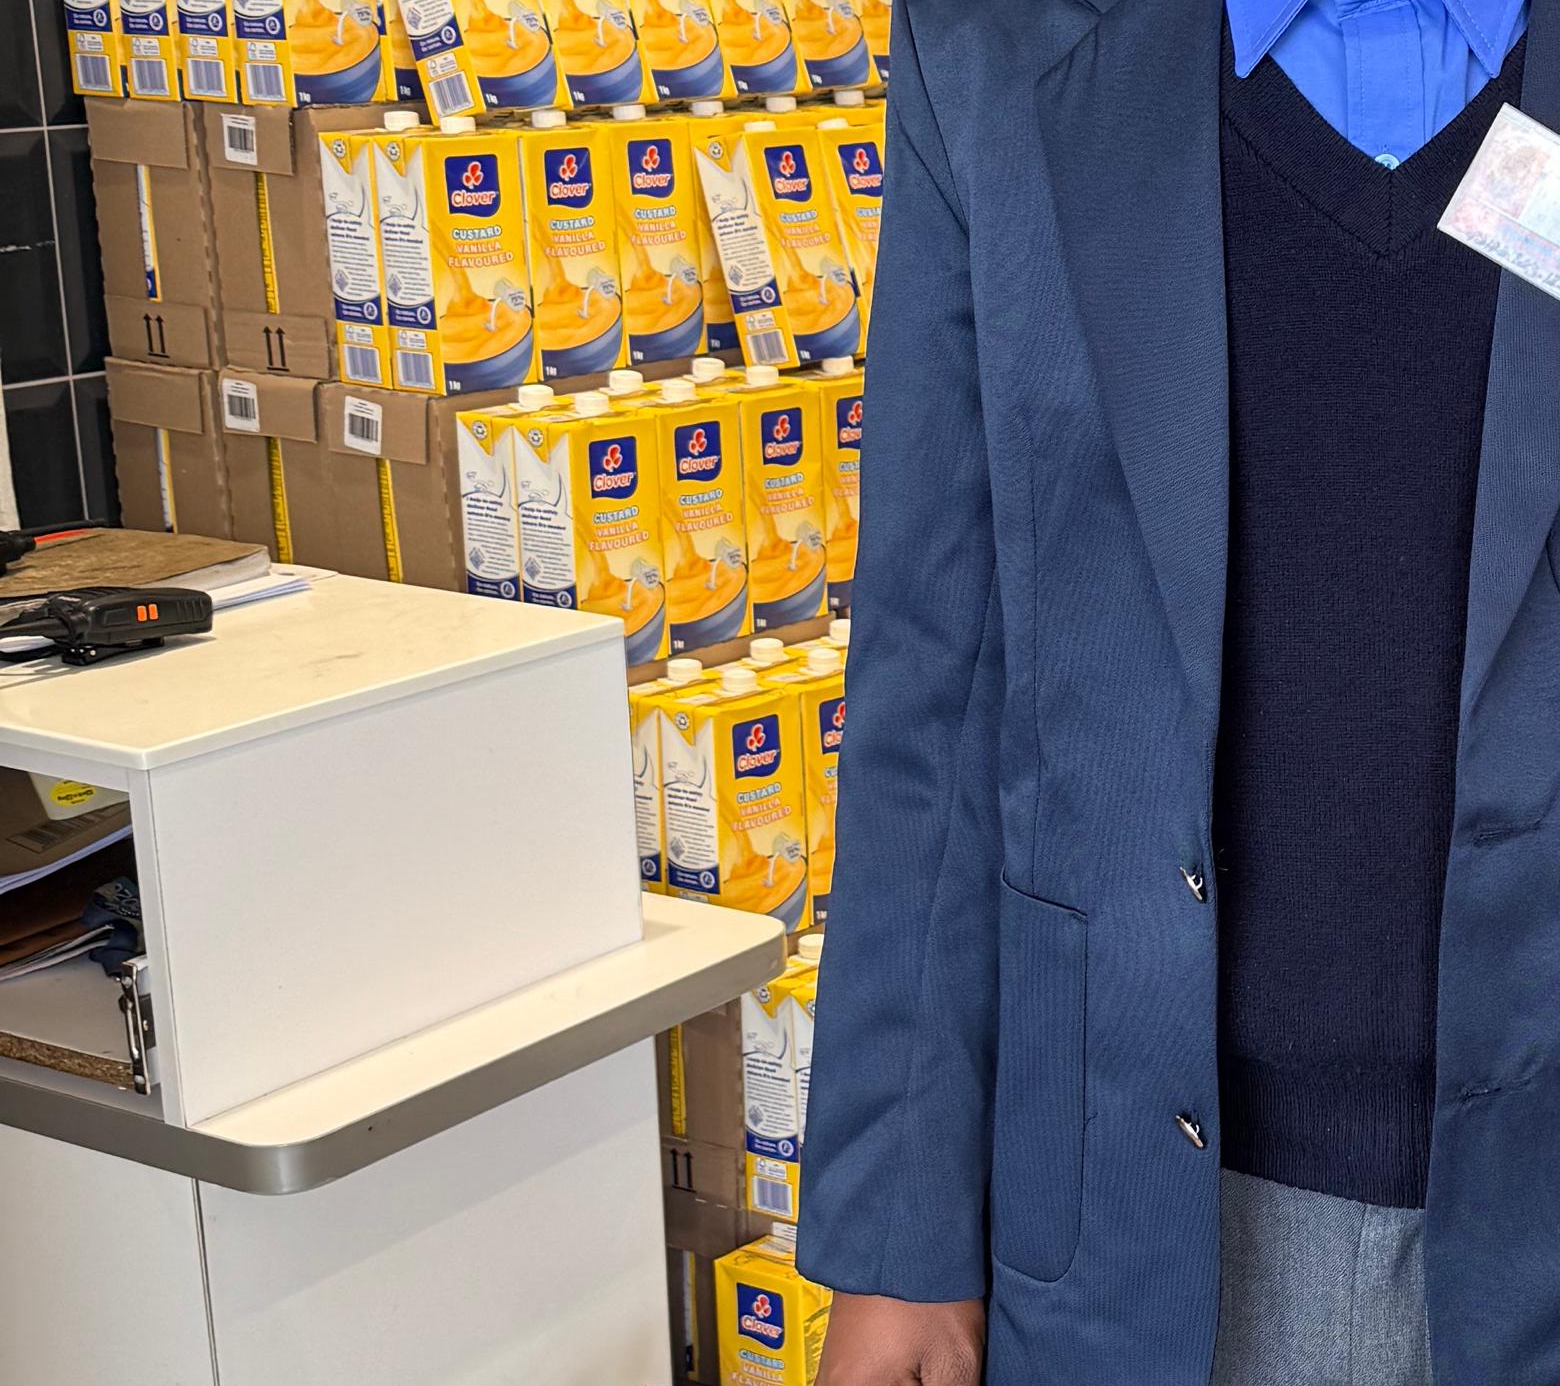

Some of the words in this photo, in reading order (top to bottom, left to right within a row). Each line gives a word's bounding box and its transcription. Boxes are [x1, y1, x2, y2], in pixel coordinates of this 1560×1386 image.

[633, 173, 671, 189] Clover
[451, 190, 496, 207] Clover
[550, 181, 589, 199] Clover
[634, 206, 676, 219] CUSTARD
[549, 217, 594, 230] CUSTARD
[452, 226, 502, 240] CUSTARD
[552, 231, 595, 243] VANILLA
[456, 242, 502, 254] VANILLA
[679, 456, 719, 475] Clover
[592, 471, 635, 491] Clover
[679, 489, 723, 506] CUSTARD
[593, 505, 639, 524] CUSTARD
[683, 503, 723, 518] VANILLA
[596, 521, 638, 537] VANILLA
[737, 749, 778, 773] Clover
[737, 782, 782, 803] CUSTARD
[740, 797, 782, 817] VANILLA
